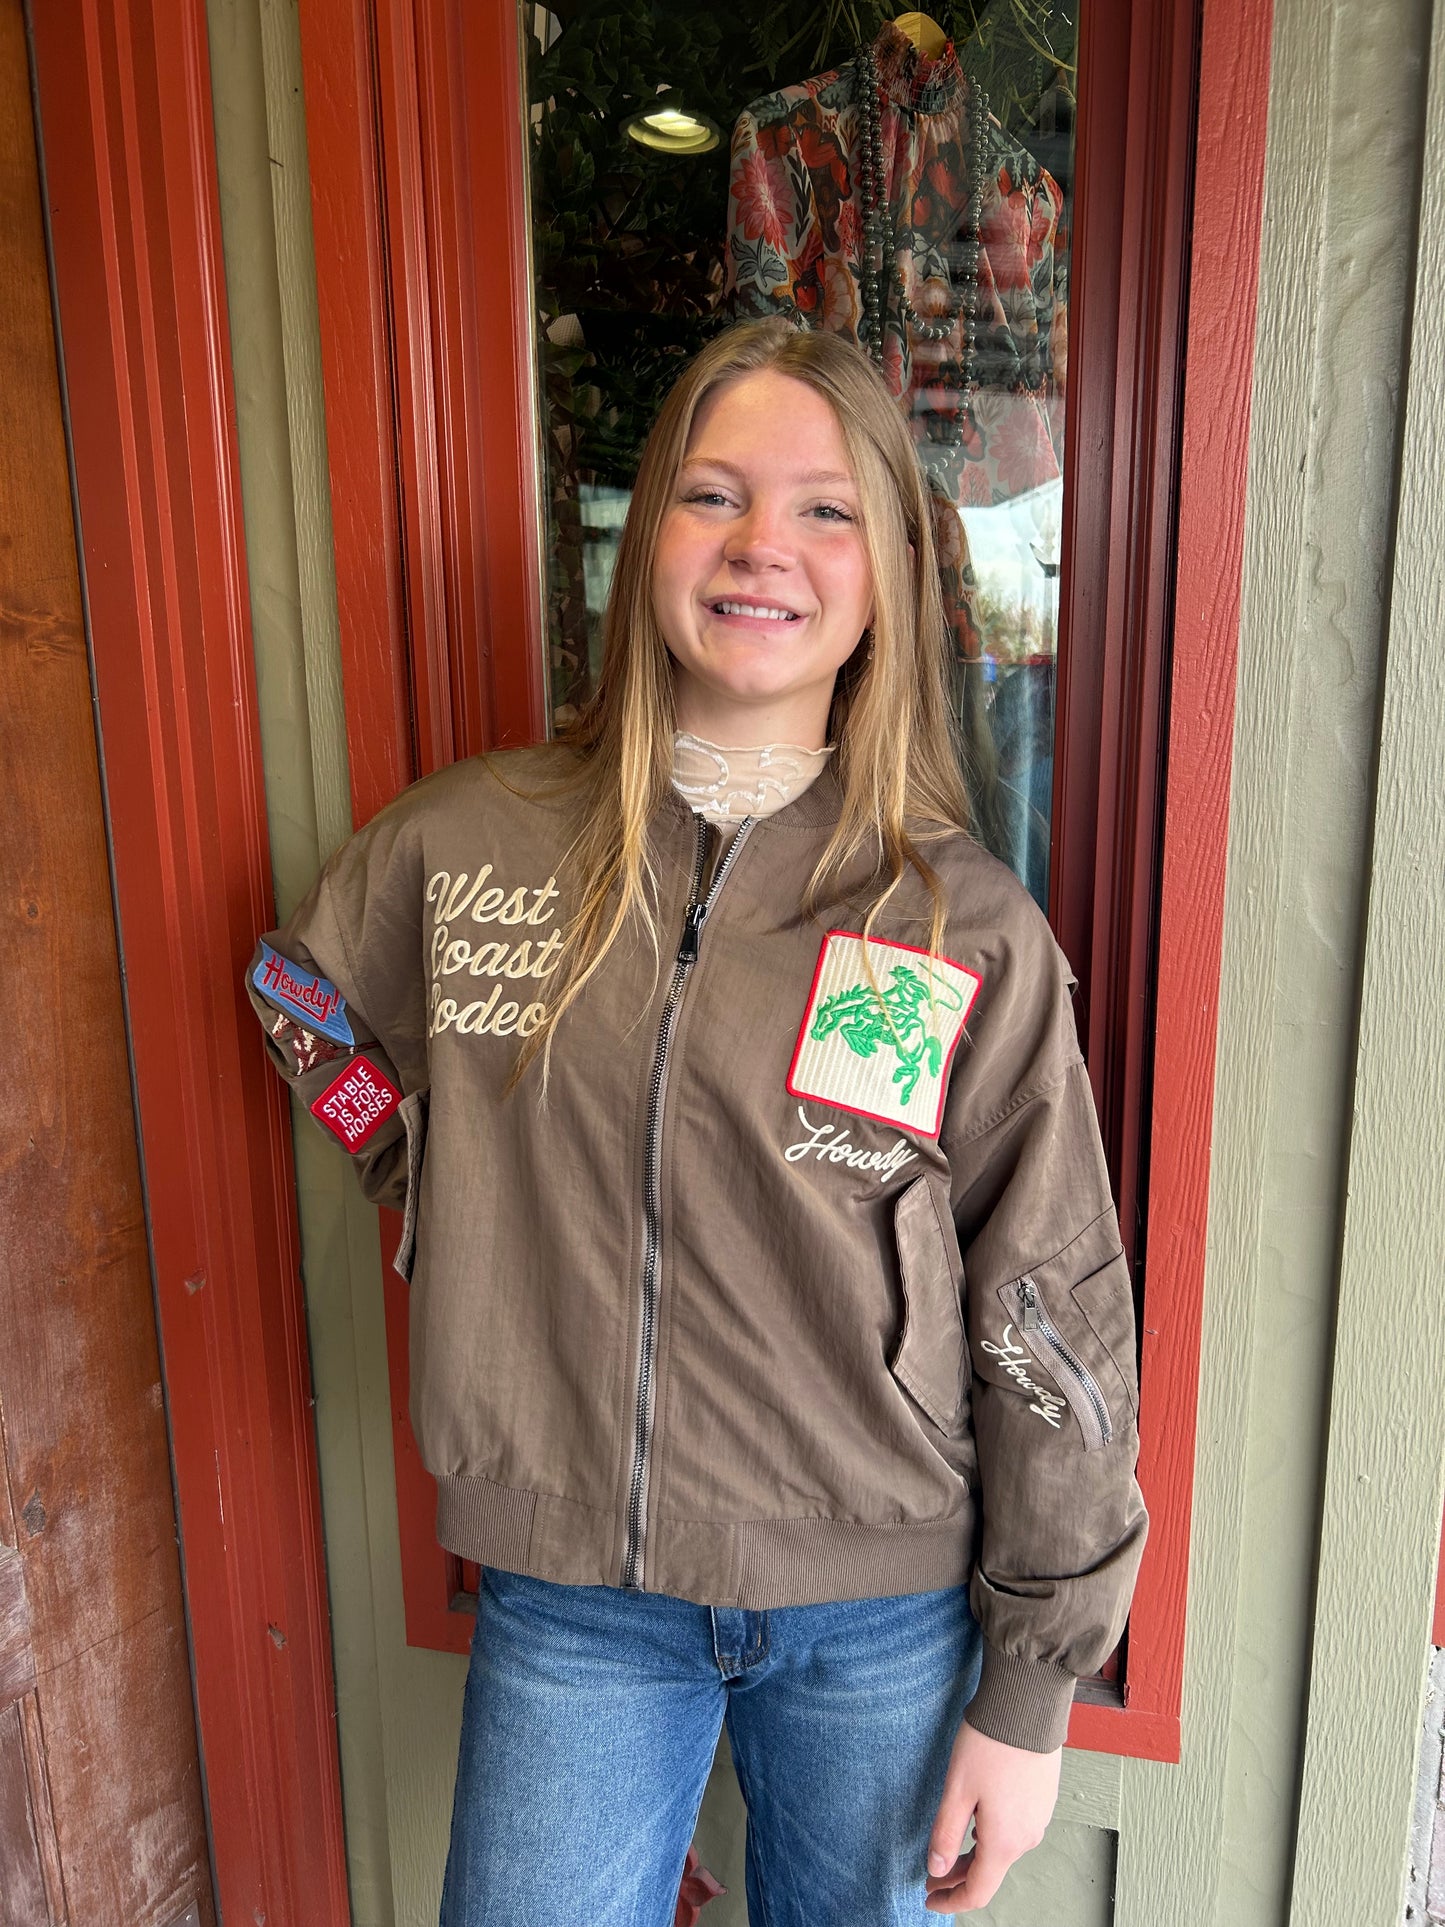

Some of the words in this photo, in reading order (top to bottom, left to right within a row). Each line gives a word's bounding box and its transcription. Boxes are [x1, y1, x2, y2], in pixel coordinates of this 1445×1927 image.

[427, 864, 560, 925] West
[432, 925, 565, 979] Coast
[262, 953, 339, 1023] Howdy!
[323, 1065, 372, 1118] STABLE
[337, 1107, 355, 1128] IS
[350, 1081, 380, 1112] FOR
[344, 1087, 393, 1143] HORSES
[784, 1105, 919, 1183] Howdy
[980, 1323, 1067, 1429] Howdy
